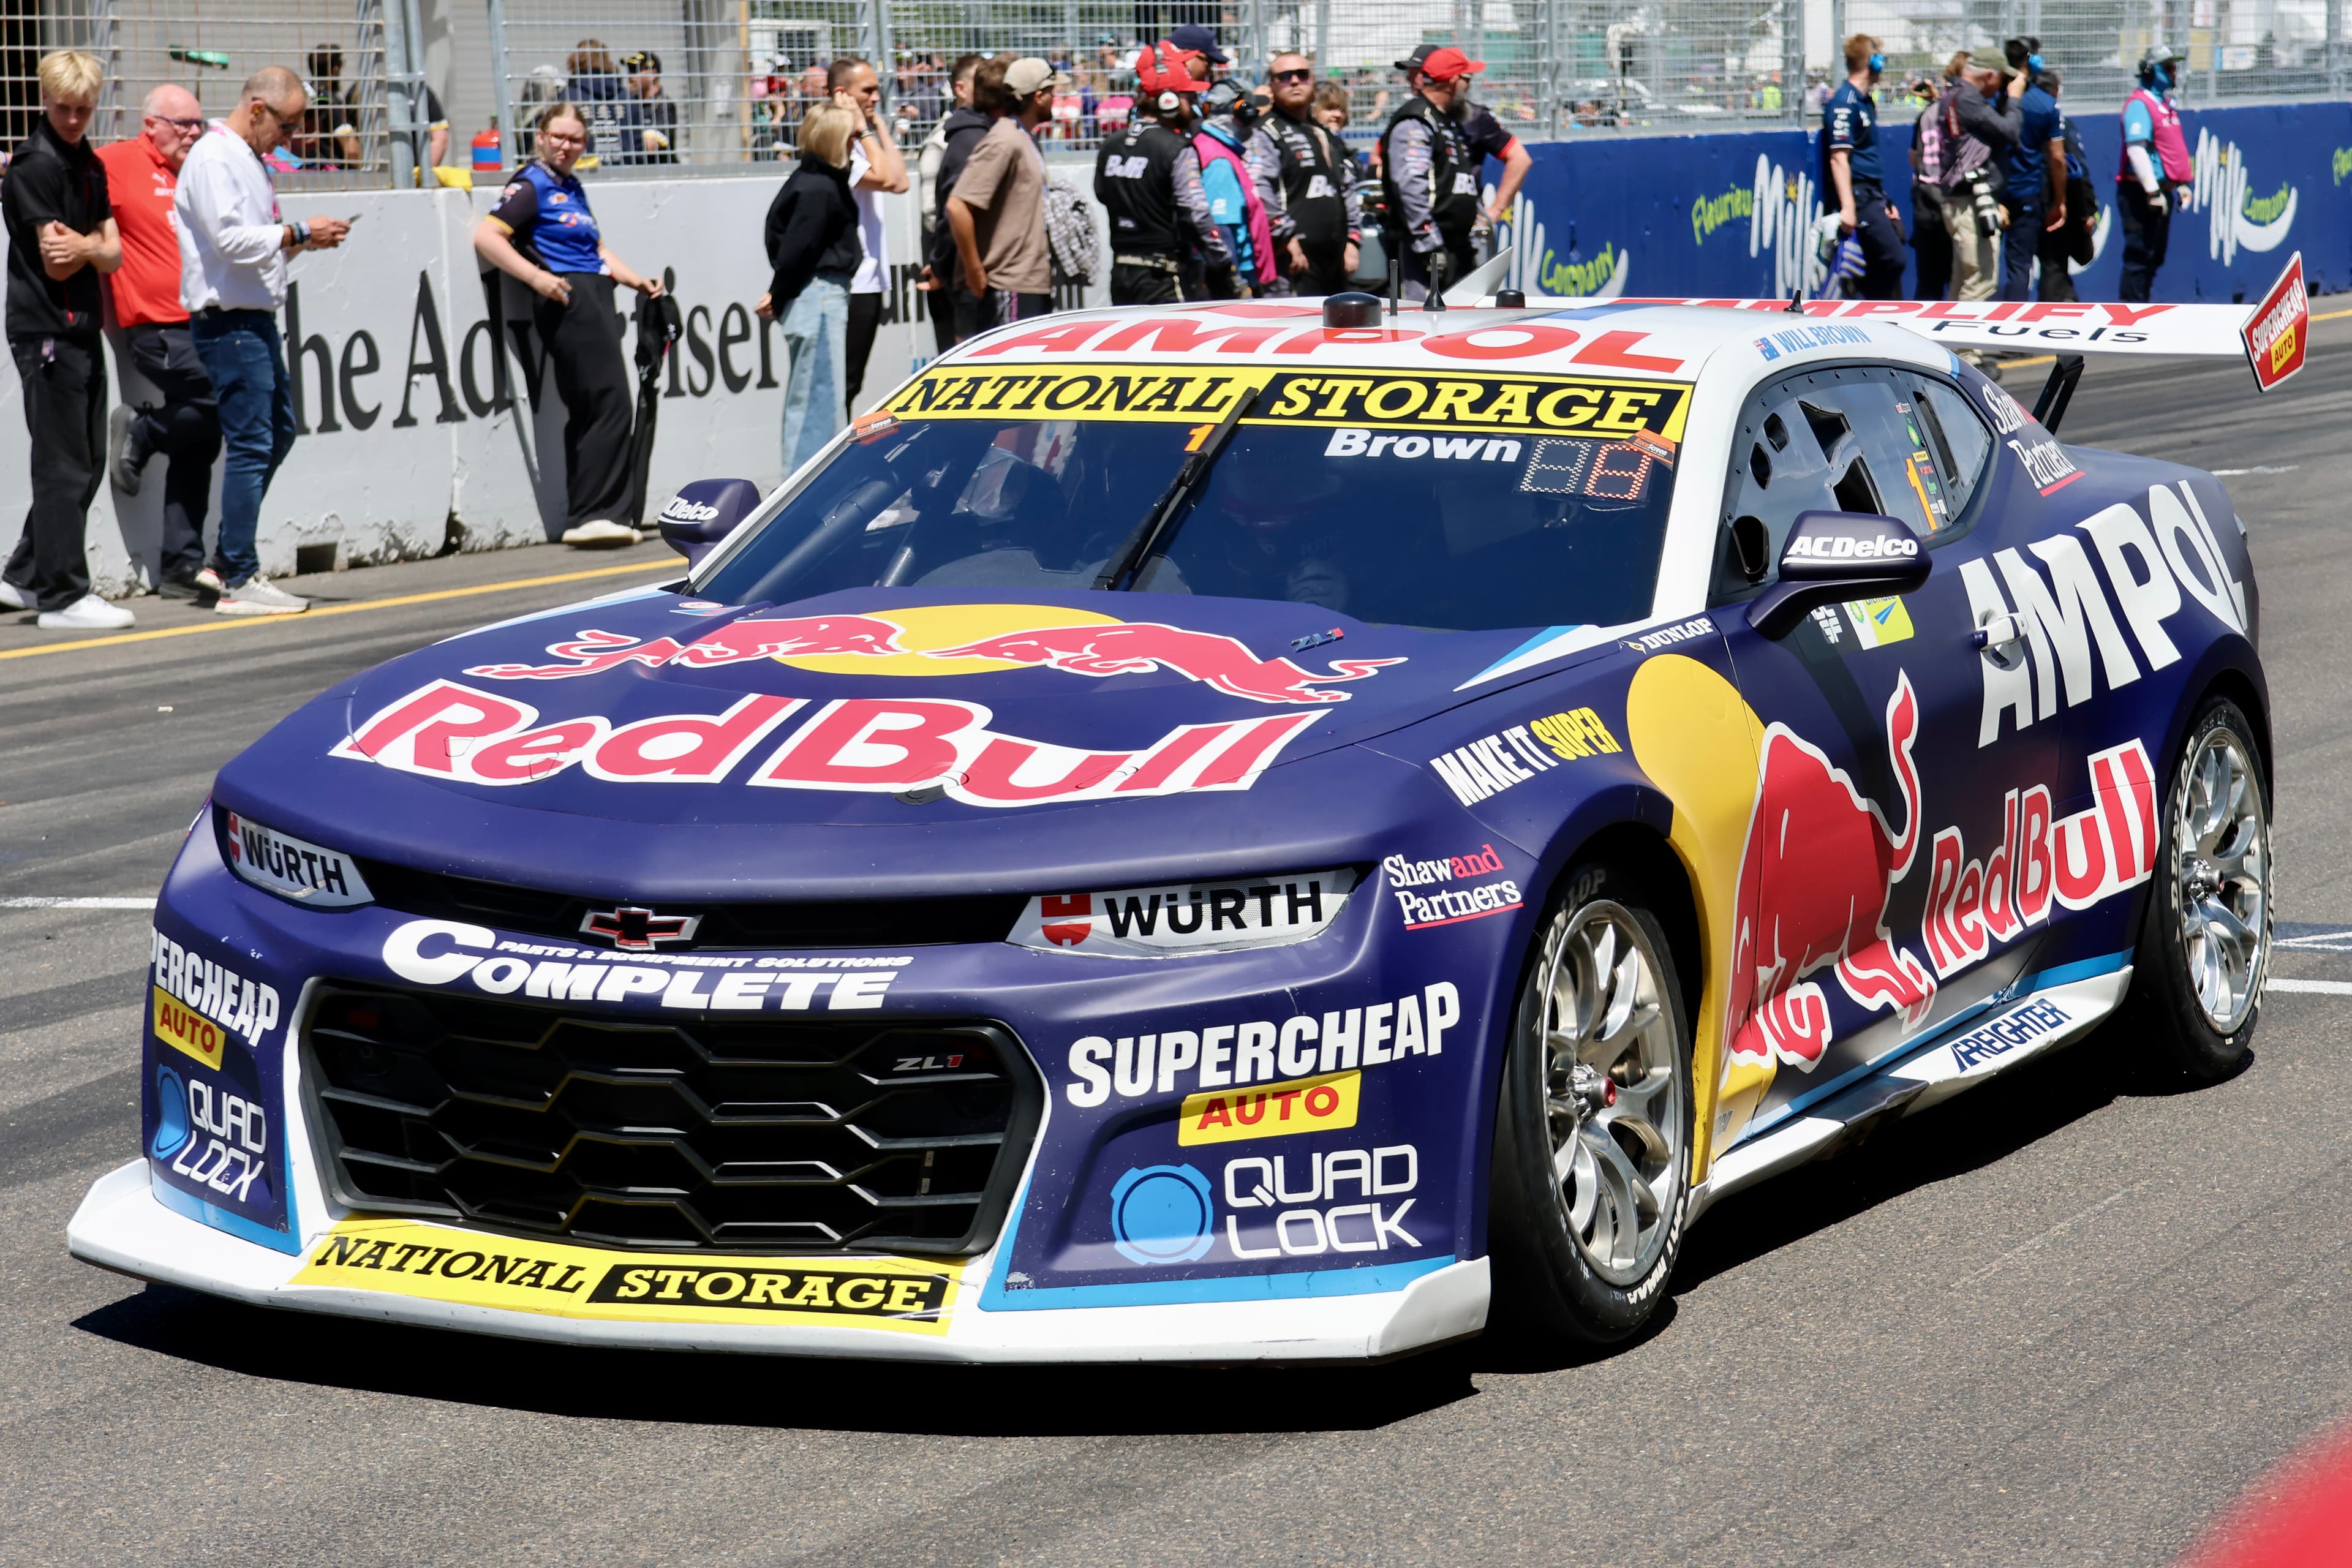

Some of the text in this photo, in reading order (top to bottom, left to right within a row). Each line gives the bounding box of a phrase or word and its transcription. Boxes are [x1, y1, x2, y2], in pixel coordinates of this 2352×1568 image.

[963, 317, 1685, 374] AMPOL
[1772, 325, 1872, 354] WILL BROWN
[1932, 320, 2150, 343] Fuels
[2252, 277, 2305, 363] SUPERCHEAP
[285, 280, 382, 436] he
[2274, 334, 2293, 366] AUTO
[895, 372, 1662, 432] NATIONAL STORAGE
[1184, 424, 1212, 451] 1
[1324, 428, 1521, 462] Brown
[1905, 458, 1938, 531] 1
[1785, 535, 1919, 559] ACDelco
[1291, 627, 1344, 654] ZL1
[1646, 617, 1714, 650] DUNLOP
[1959, 479, 2248, 749] AMPOL
[1429, 707, 1623, 807] MAKE IT SUPER
[241, 826, 350, 897] WÜRTH
[1104, 880, 1324, 939] WÜRTH
[1395, 880, 1521, 925] Partners
[496, 940, 914, 968] PARTS & EQUIPMENT SOLUTIONS
[160, 1003, 217, 1054] AUTO
[1066, 981, 1461, 1109] SUPERCHEAP
[892, 1054, 965, 1072] ZL1
[189, 1078, 267, 1155] QUAD
[1197, 1085, 1340, 1131] AUTO
[172, 1130, 266, 1202] LOCK
[1224, 1144, 1419, 1208] QUAD
[1226, 1197, 1423, 1260] LOCK
[315, 1236, 929, 1313] NATIONAL STORAGE
